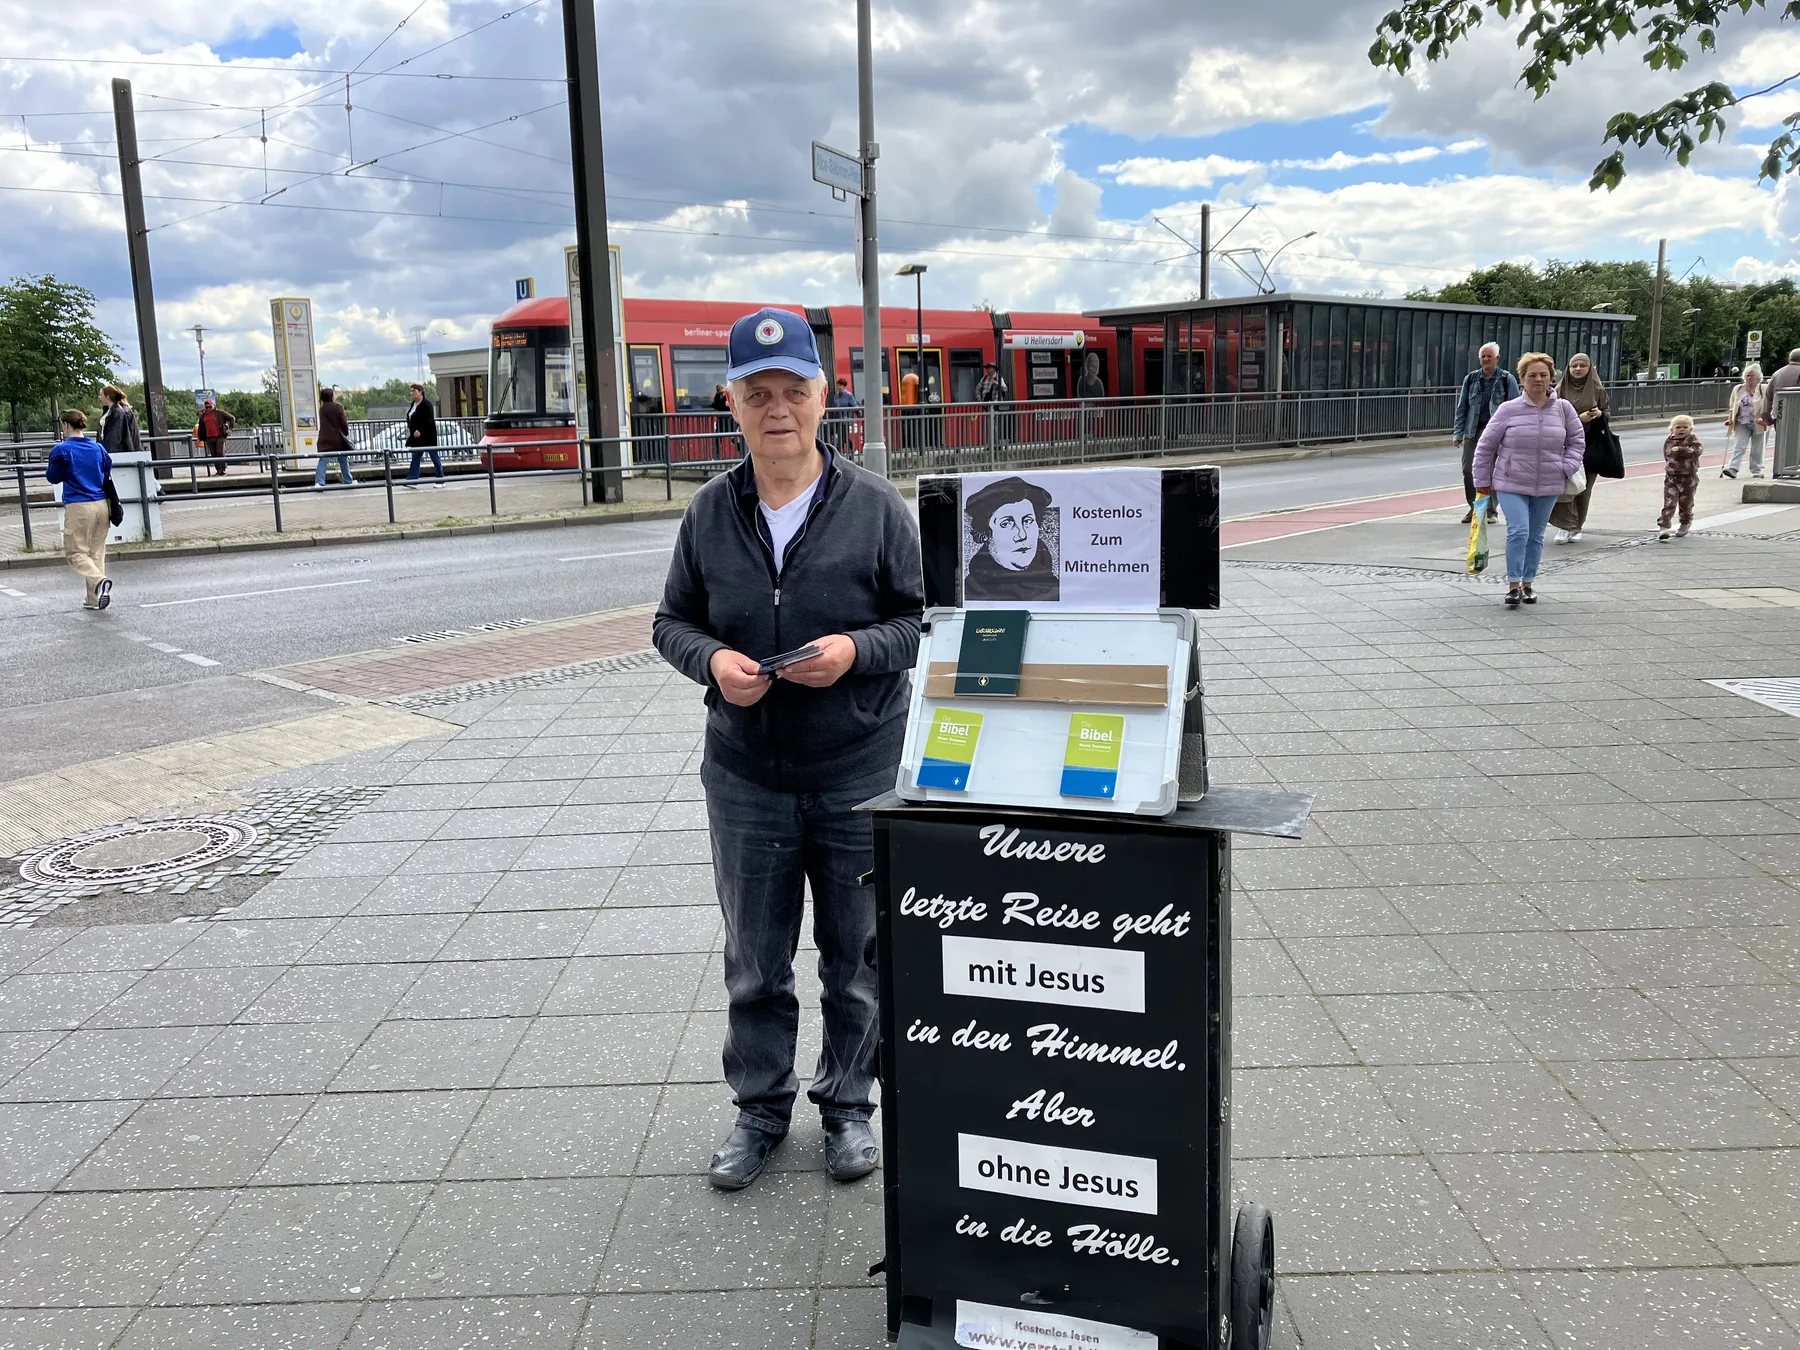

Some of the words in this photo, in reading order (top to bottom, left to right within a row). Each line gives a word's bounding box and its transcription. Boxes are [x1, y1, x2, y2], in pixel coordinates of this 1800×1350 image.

[519, 281, 527, 298] U
[1024, 336, 1030, 345] U
[1030, 336, 1064, 345] Hellersdorf
[1072, 505, 1142, 519] Kostenlos
[1091, 533, 1122, 546] Zum
[1065, 559, 1149, 573] Mitnehmen
[940, 722, 969, 737] Bibel
[1080, 728, 1113, 742] Bibel
[978, 823, 1107, 865] Unsere
[899, 886, 989, 930] letzte
[1001, 891, 1102, 930] Reise
[1112, 903, 1191, 944] geht
[968, 959, 1017, 986] mit
[1025, 963, 1105, 994] Jesus
[906, 1018, 941, 1044] in
[951, 1019, 1012, 1052] den
[1026, 1022, 1187, 1072] Himmel.
[1005, 1088, 1096, 1128] Aber
[977, 1154, 1050, 1188] ohne
[1058, 1165, 1139, 1199] Jesus
[955, 1214, 990, 1238] in
[1000, 1217, 1053, 1248] die
[1066, 1224, 1180, 1267] Hölle.
[1015, 1320, 1068, 1338] Kostenlos
